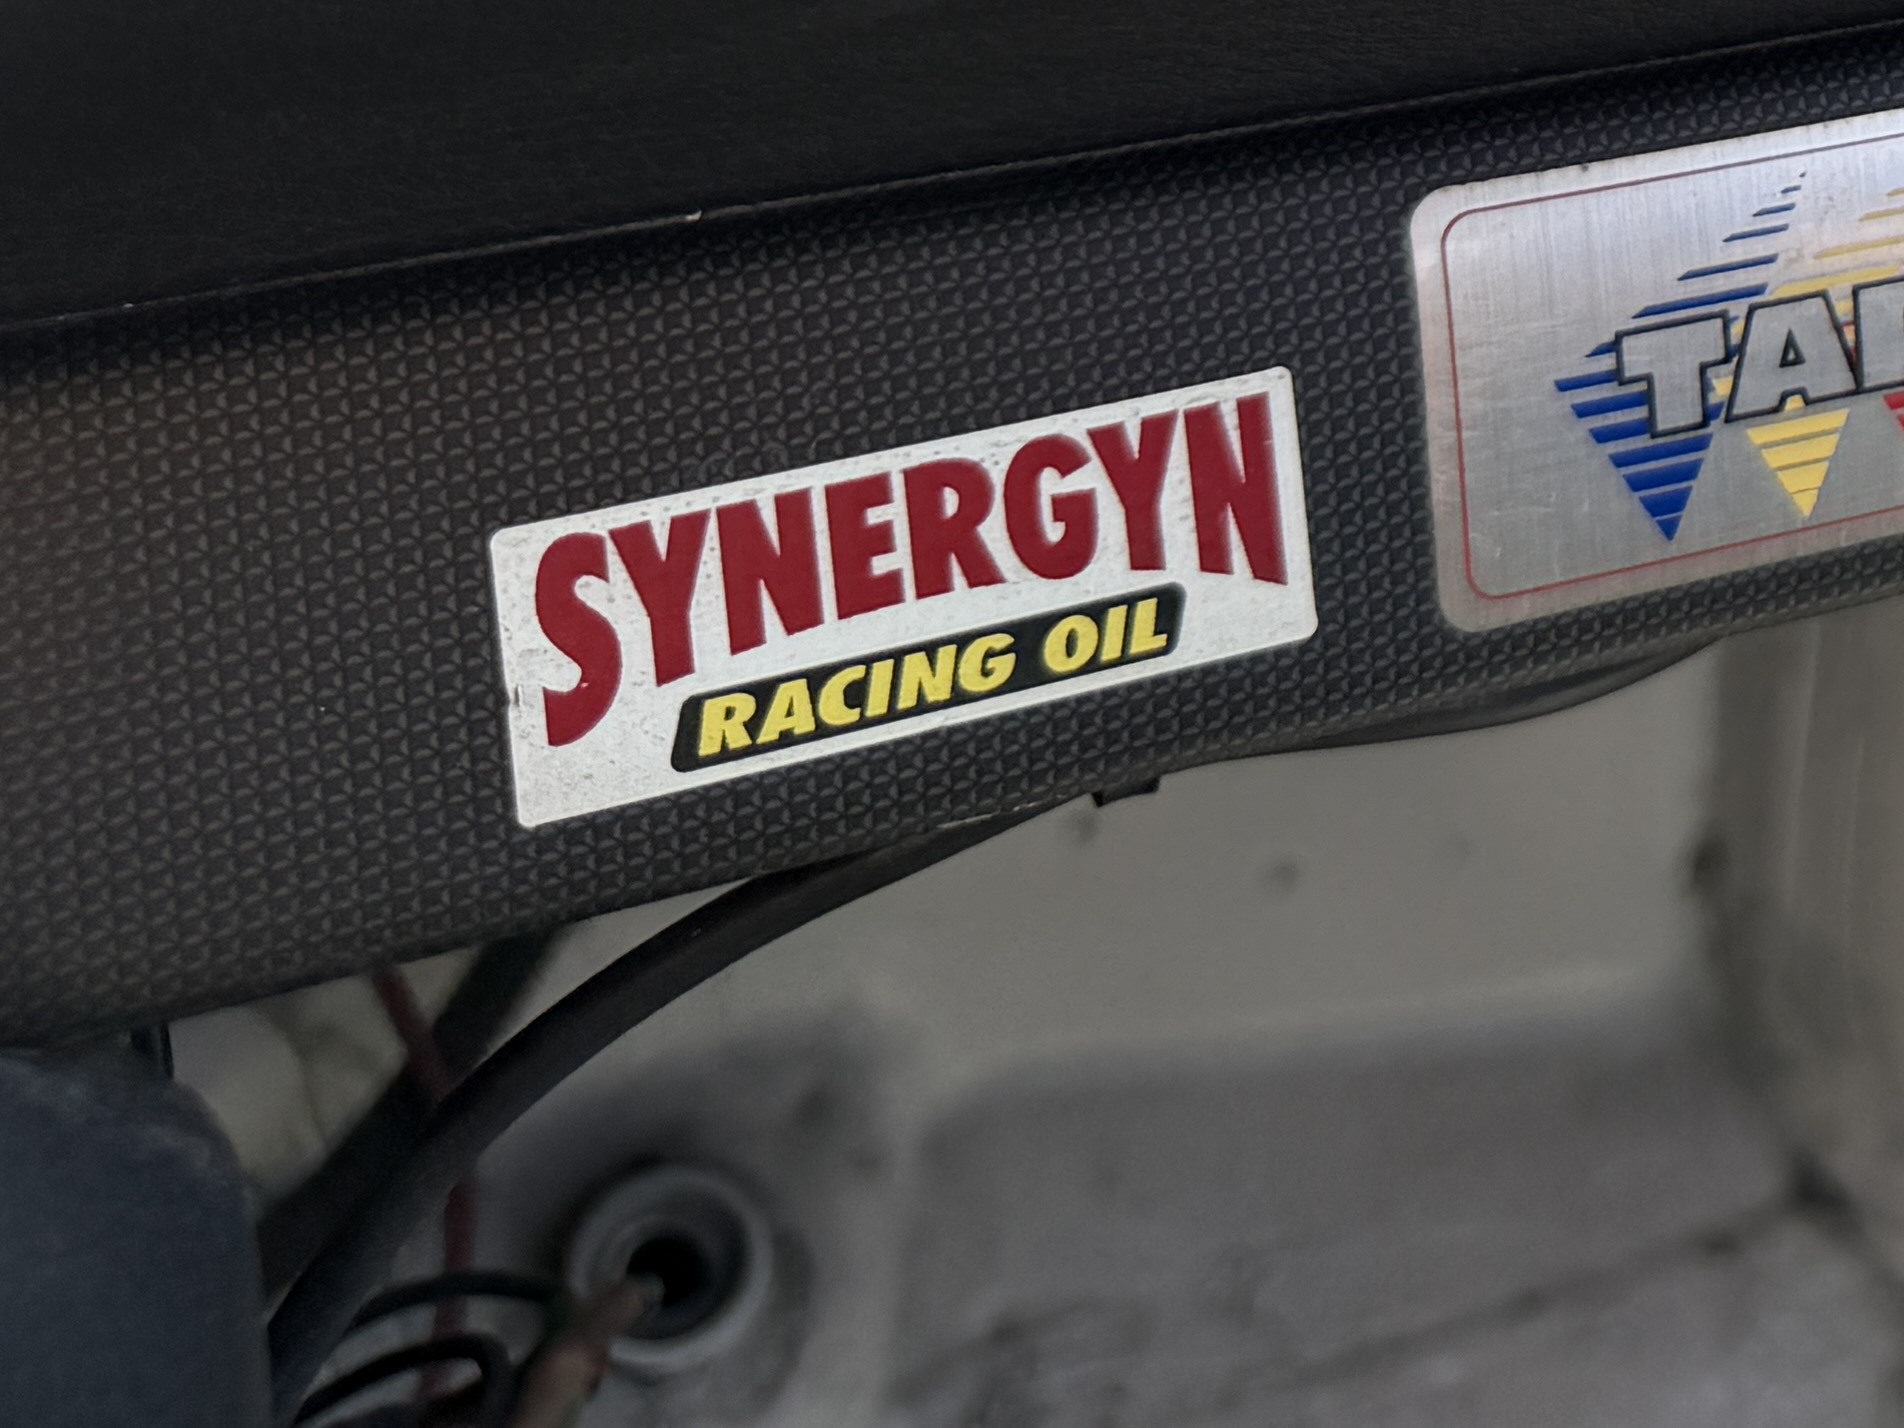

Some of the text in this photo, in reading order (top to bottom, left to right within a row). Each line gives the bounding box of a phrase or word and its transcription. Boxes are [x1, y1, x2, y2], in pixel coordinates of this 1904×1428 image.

[533, 390, 1289, 748] SYNERGYN
[695, 596, 1169, 759] RACING OIL
